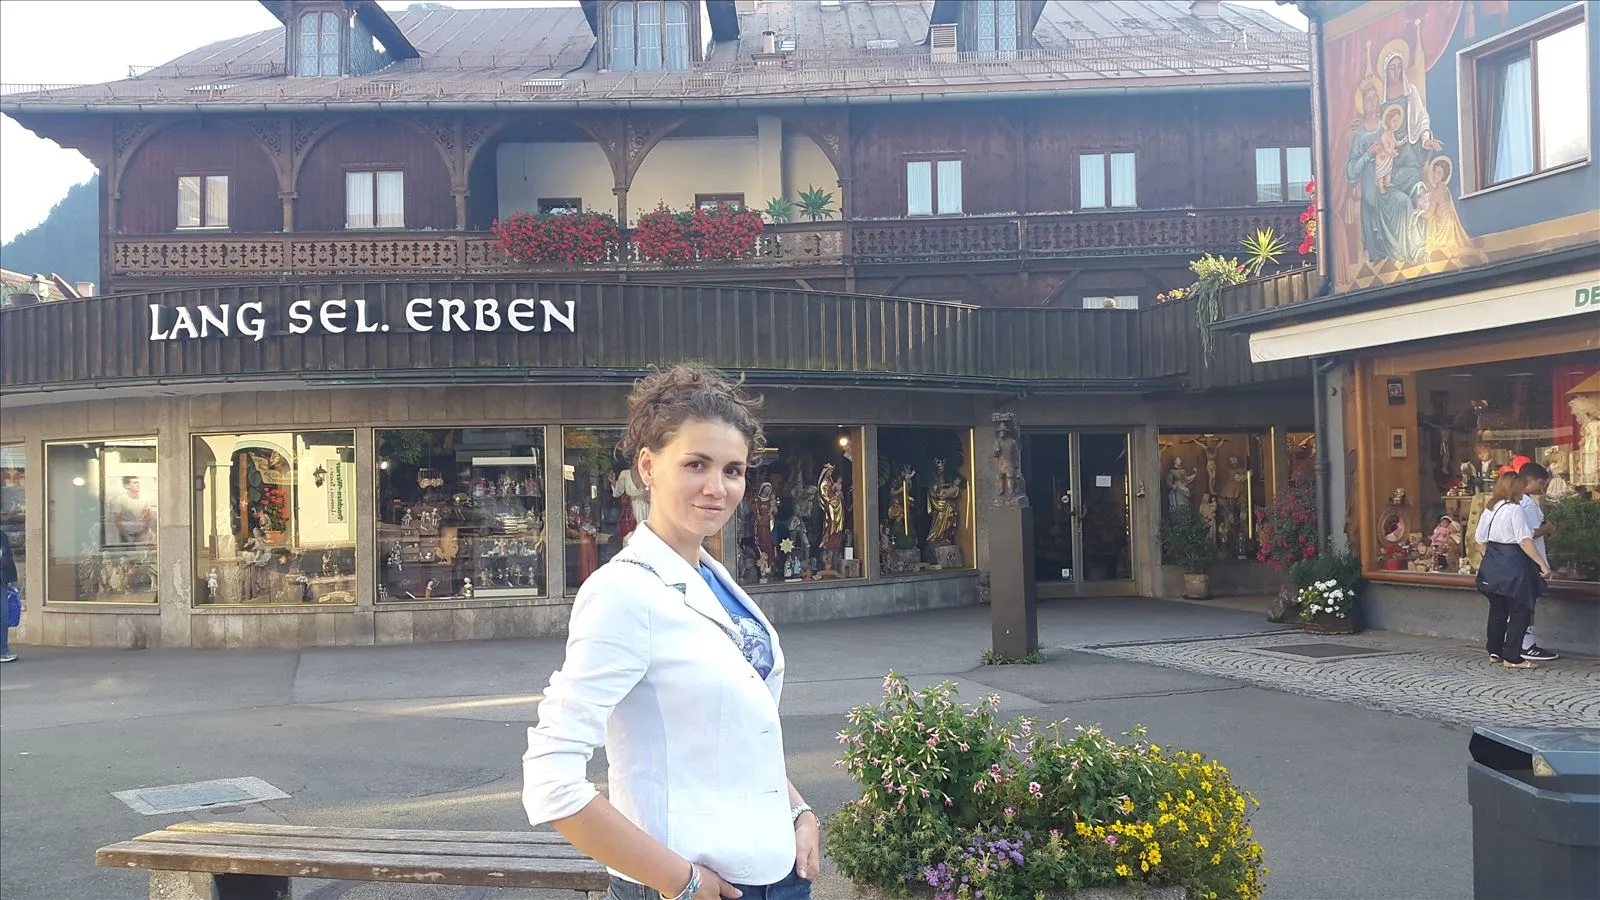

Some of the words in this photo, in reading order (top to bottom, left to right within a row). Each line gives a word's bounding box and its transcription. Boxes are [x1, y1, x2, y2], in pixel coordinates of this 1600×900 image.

[1575, 286, 1600, 307] DE
[149, 302, 266, 342] LANG
[288, 299, 390, 334] SEL.
[405, 298, 577, 334] ERBEN
